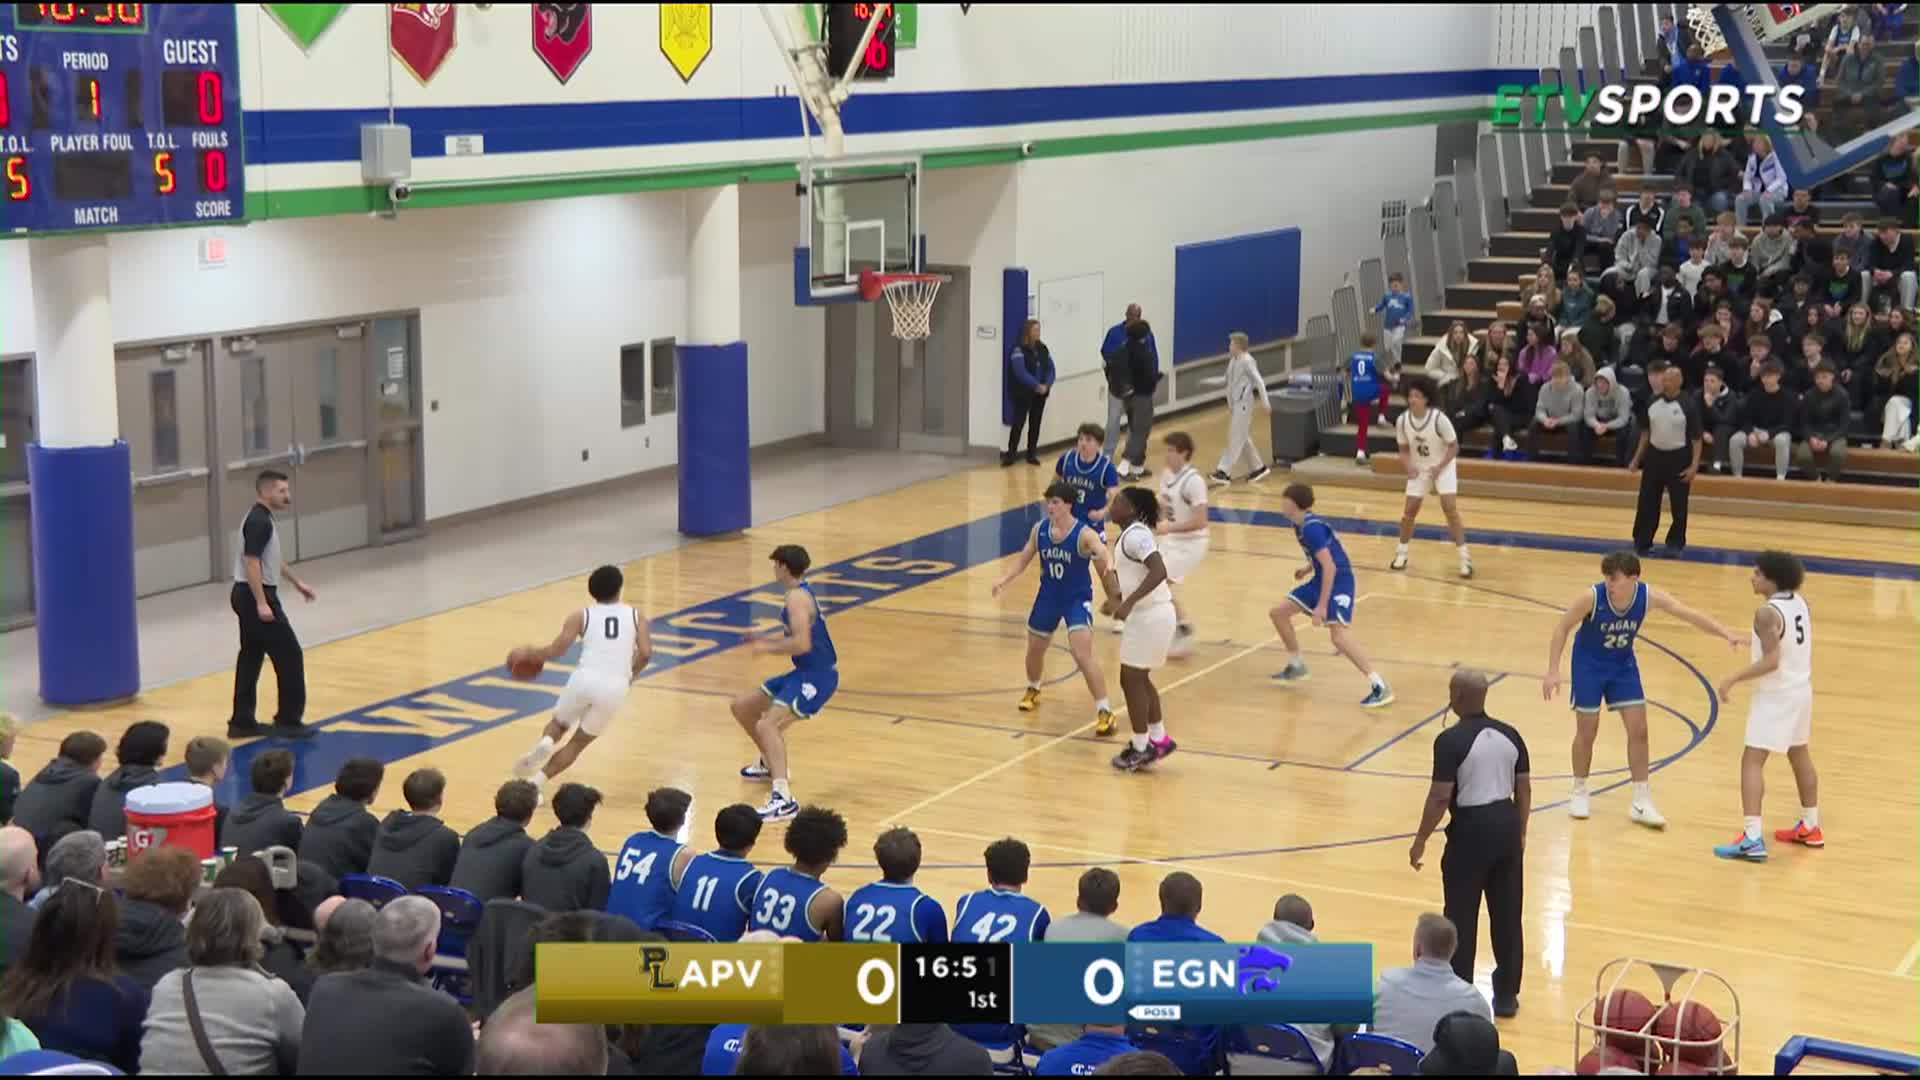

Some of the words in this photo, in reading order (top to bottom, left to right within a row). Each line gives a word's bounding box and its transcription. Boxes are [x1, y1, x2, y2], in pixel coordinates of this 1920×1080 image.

[62, 51, 109, 71] PERIOD
[163, 38, 219, 65] GUEST
[90, 79, 101, 118] 1
[198, 70, 224, 125] 0
[50, 133, 100, 153] PLAYER
[102, 132, 135, 151] FOUL
[147, 132, 180, 149] T.O.L.
[191, 131, 229, 148] FOULS
[7, 156, 31, 200] 5
[154, 152, 176, 194] 5
[205, 149, 226, 192] 0
[73, 206, 119, 225] MATCH
[195, 200, 232, 218] SCORE
[1048, 562, 1065, 580] 10
[604, 617, 619, 640] 0
[1600, 620, 1638, 633] EAGAN
[1794, 615, 1805, 645] 5
[135, 830, 151, 848] G
[616, 847, 657, 885] 54
[691, 875, 720, 912] 11
[755, 887, 797, 930] 33
[852, 903, 897, 942] 22
[971, 911, 1018, 942] 42
